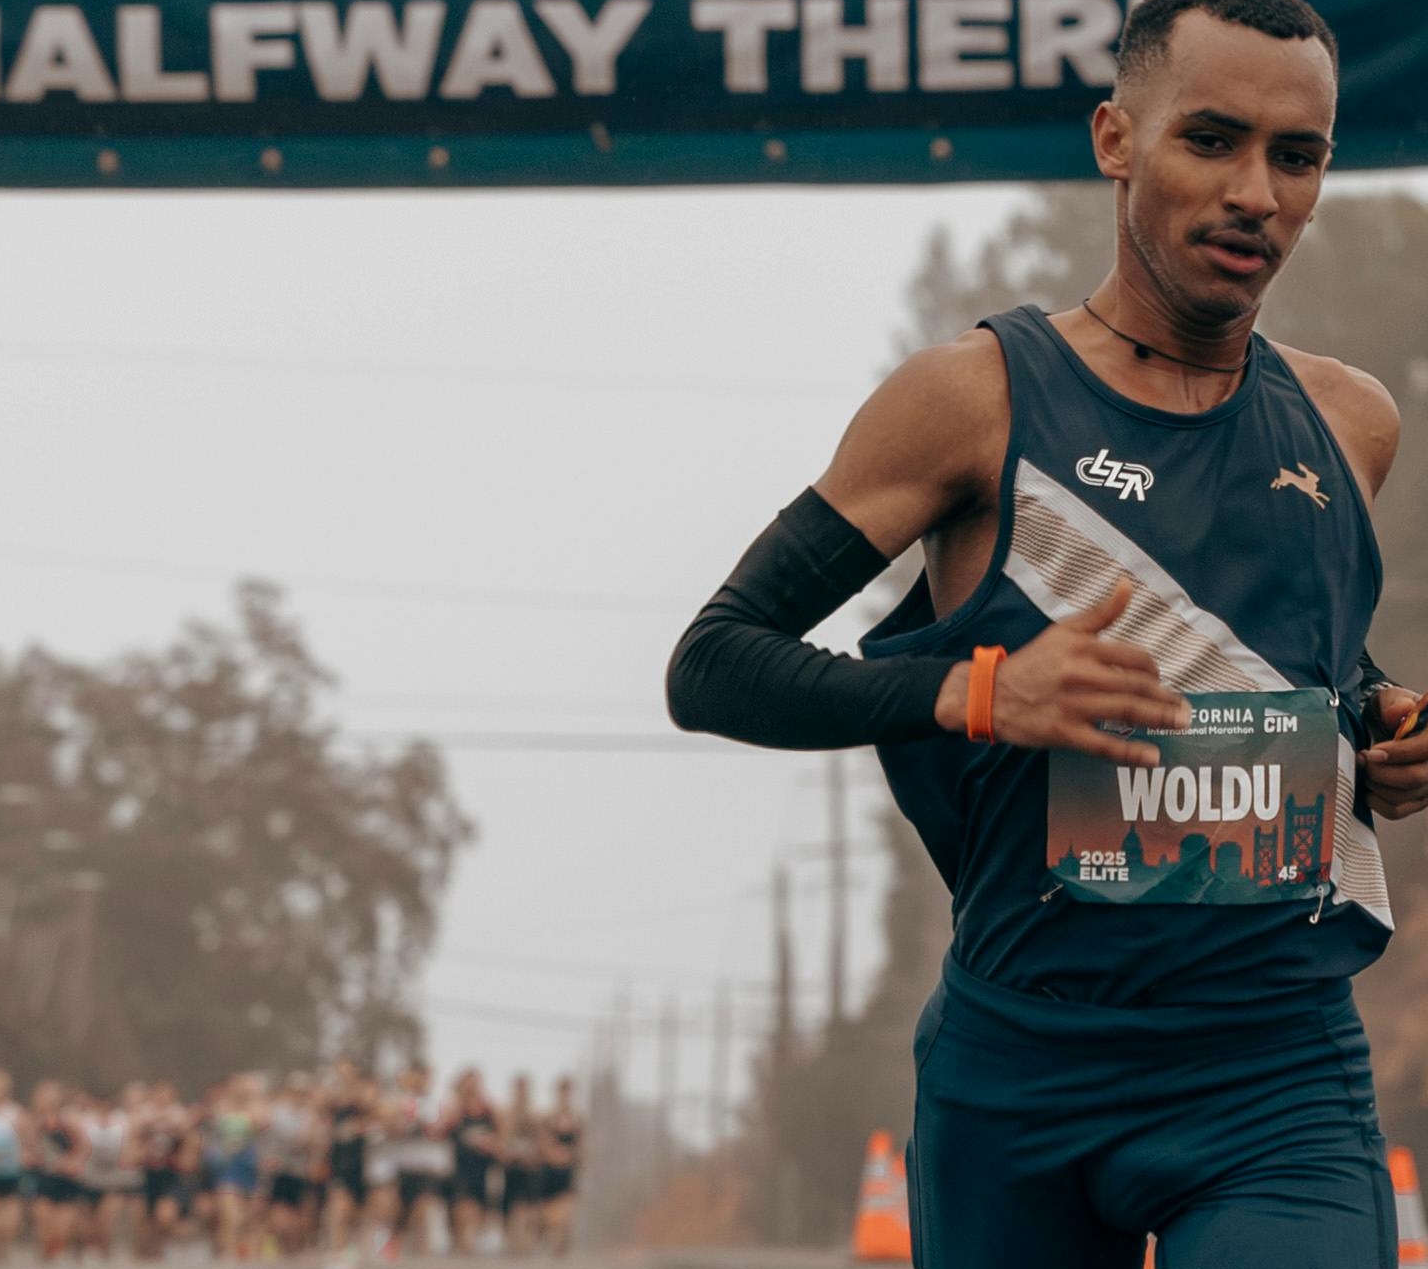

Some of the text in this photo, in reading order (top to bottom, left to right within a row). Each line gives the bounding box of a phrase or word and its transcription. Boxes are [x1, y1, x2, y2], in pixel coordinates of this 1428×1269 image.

[1209, 724, 1254, 735] Marathon
[1263, 716, 1298, 733] CIM
[1117, 764, 1281, 823] WOLDU
[1079, 851, 1126, 866] 2025
[1079, 866, 1129, 881] ELITE
[1278, 865, 1298, 880] 45
